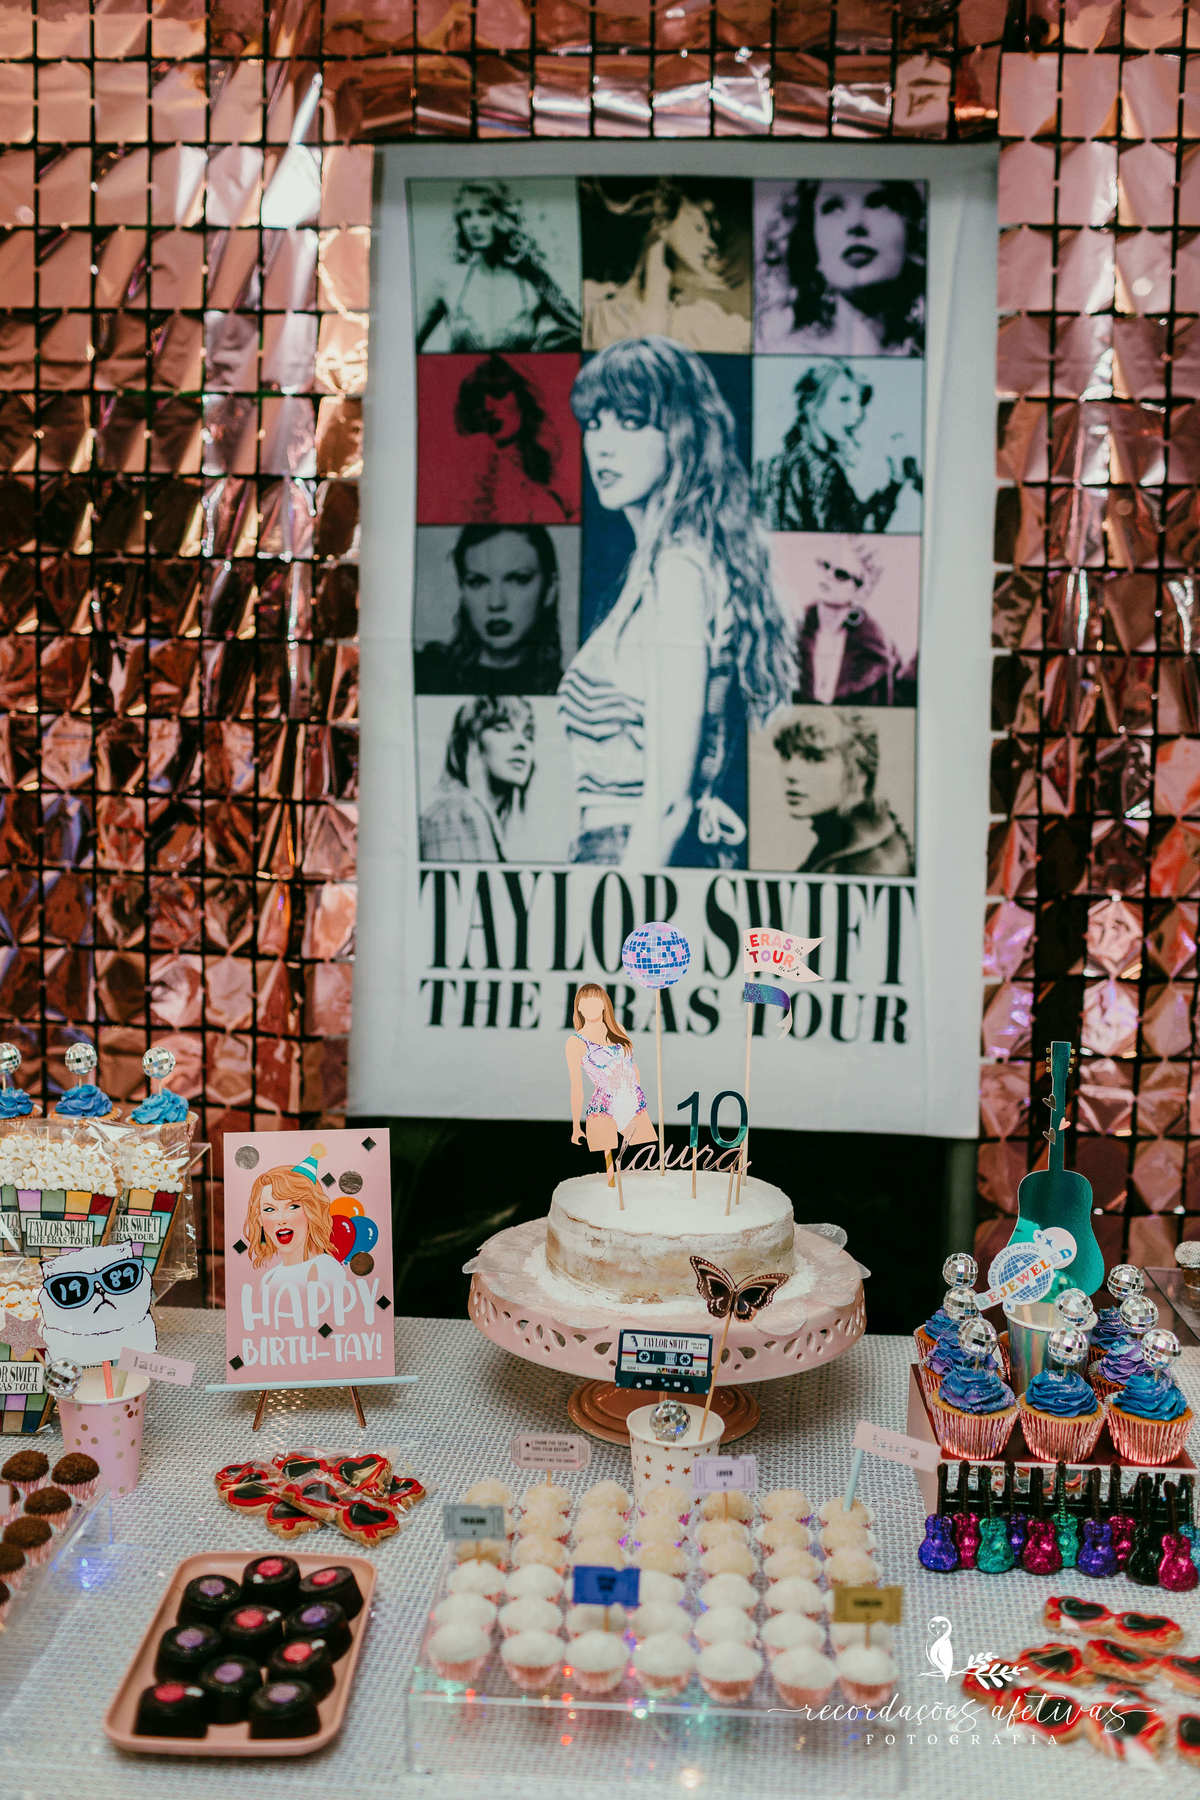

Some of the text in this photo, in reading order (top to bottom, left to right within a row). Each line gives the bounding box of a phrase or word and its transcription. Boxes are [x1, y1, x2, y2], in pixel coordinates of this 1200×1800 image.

[749, 934, 793, 951] ERAS
[749, 950, 795, 968] TOUR
[418, 978, 541, 1030] THE
[677, 1090, 748, 1149] 10
[28, 1220, 63, 1237] TAYLOR
[64, 1221, 92, 1238] SWIFT
[131, 1217, 159, 1233] SWIFT
[29, 1235, 92, 1245] THE ERAS TOUR
[133, 1232, 155, 1241] TOUR
[241, 1278, 380, 1332] HAPPY
[241, 1331, 383, 1368] BIRTH-TAY!
[643, 1336, 668, 1349] TAYLOR
[669, 1338, 689, 1351] SWIFT
[10, 1366, 40, 1383] SWIFT
[14, 1382, 38, 1392] TOUR
